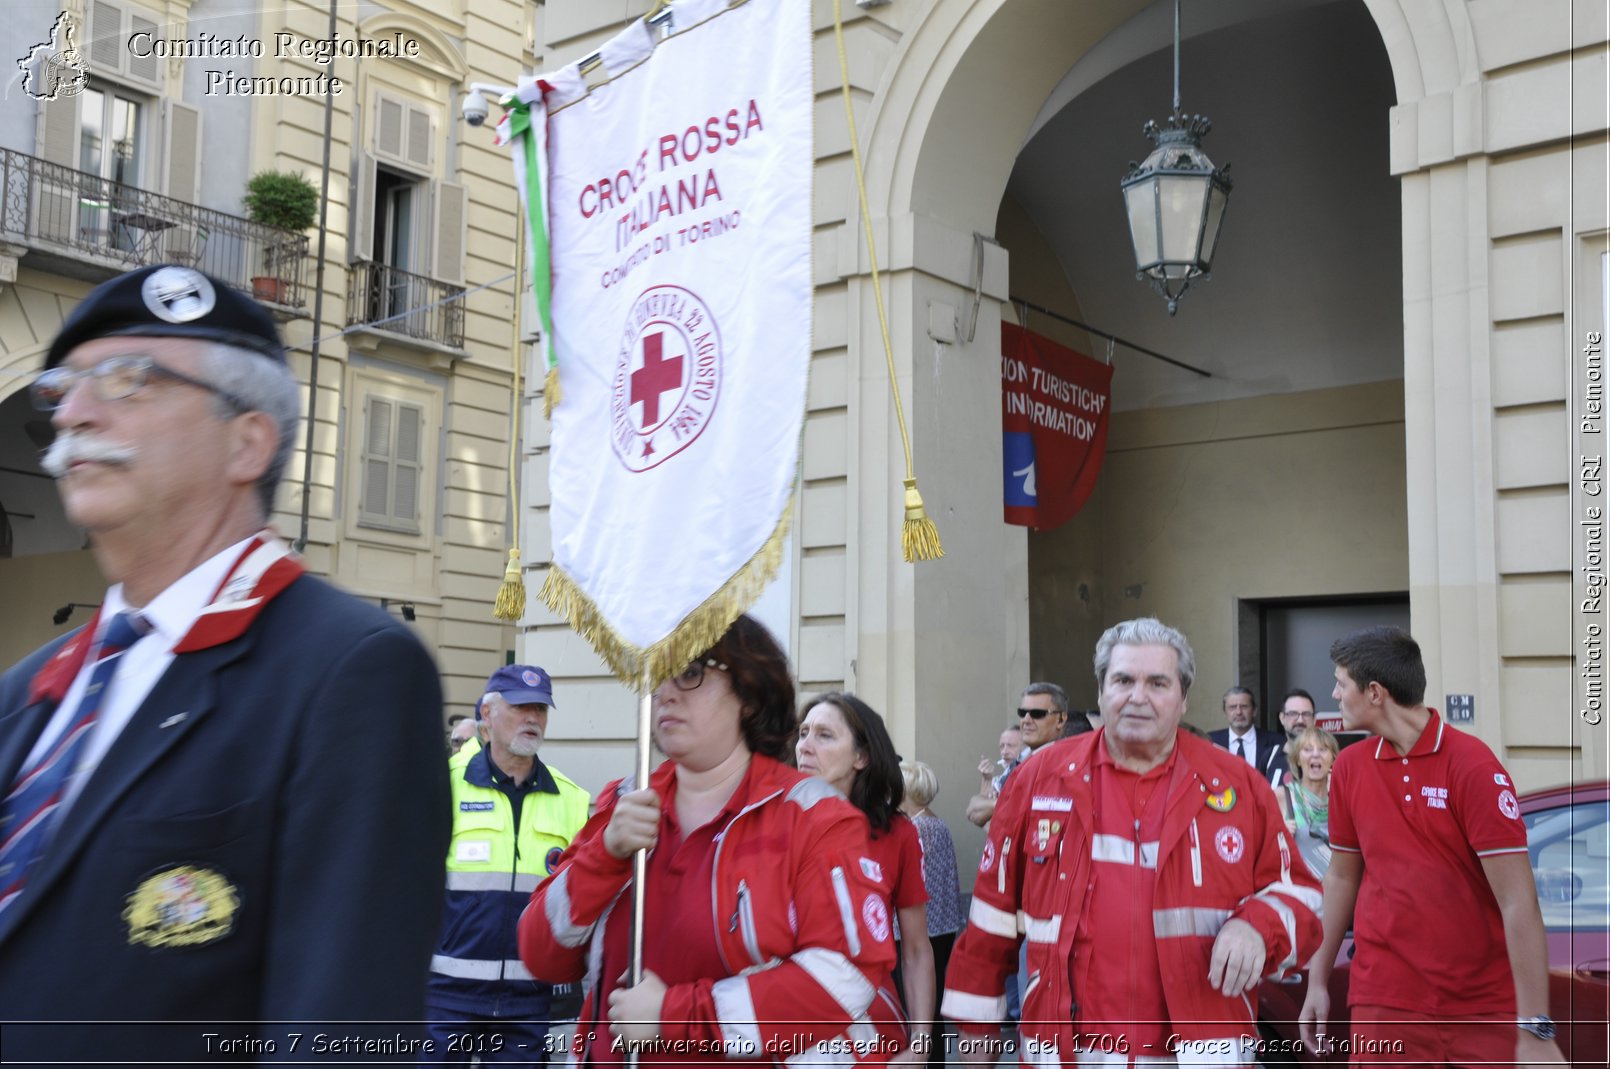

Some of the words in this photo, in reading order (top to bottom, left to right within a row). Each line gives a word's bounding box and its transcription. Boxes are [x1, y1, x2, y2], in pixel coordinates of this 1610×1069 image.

[579, 148, 648, 219] CROCE
[659, 99, 763, 172] ROSSA
[616, 168, 723, 253] ITALIANA
[654, 232, 670, 255] DI
[677, 209, 741, 247] TORINO
[690, 331, 716, 401] AGOSTO
[1001, 356, 1028, 383] ION
